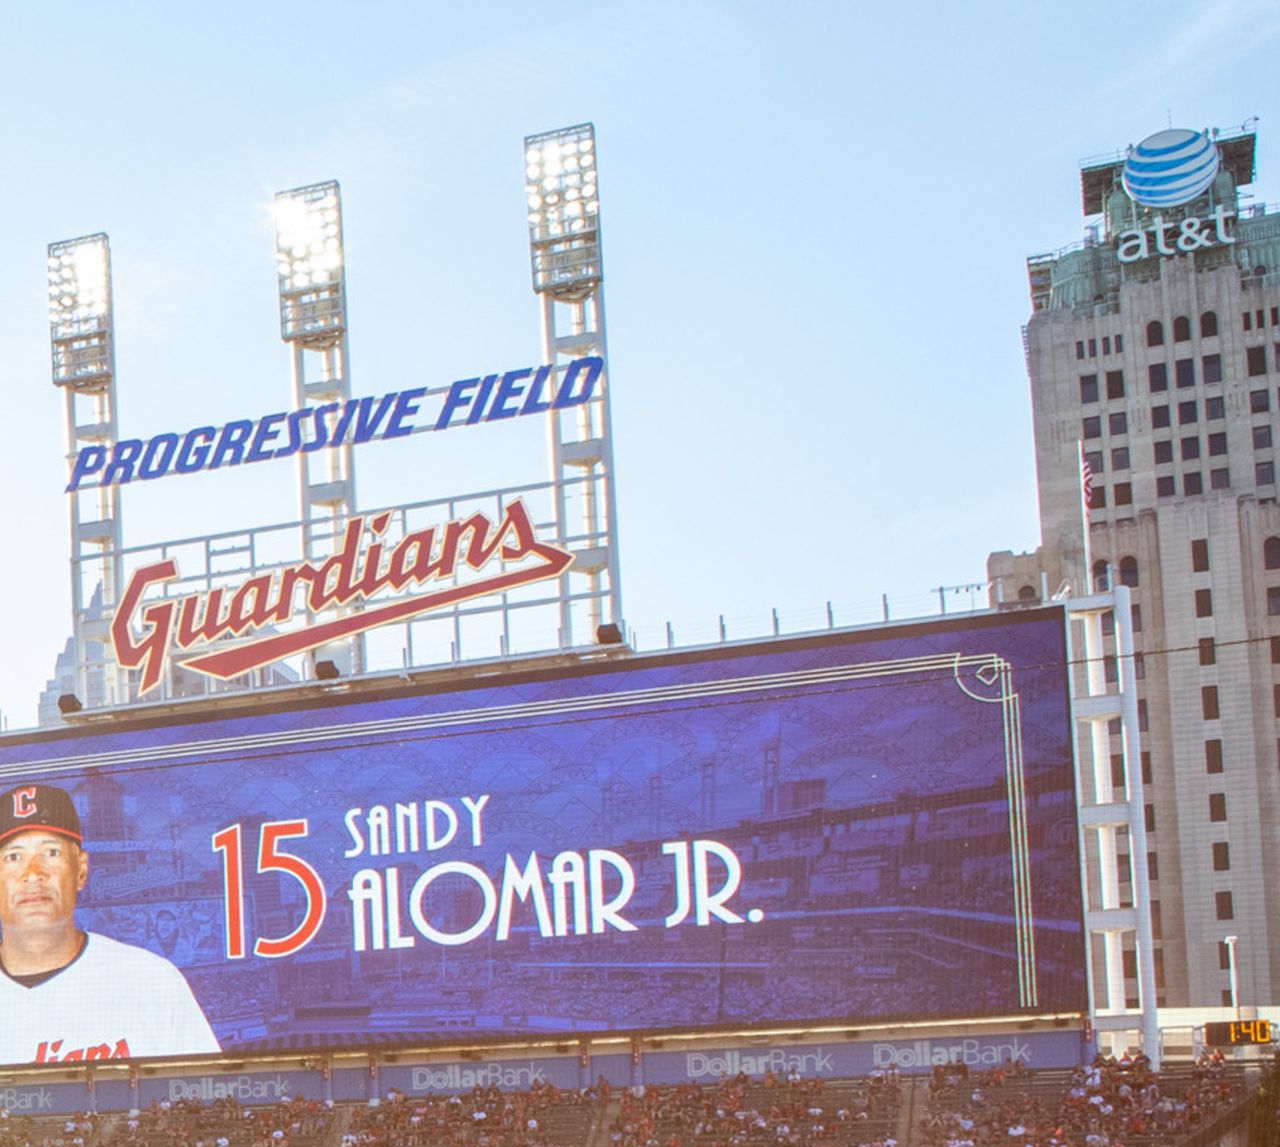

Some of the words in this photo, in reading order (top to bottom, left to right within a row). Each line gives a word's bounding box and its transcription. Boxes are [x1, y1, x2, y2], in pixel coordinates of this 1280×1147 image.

[1116, 203, 1236, 264] at&t
[66, 386, 428, 493] PROGRESSIVE
[435, 355, 604, 431] FIELD
[110, 496, 577, 697] Guardians
[344, 795, 490, 858] SANDY
[211, 818, 327, 960] 15
[347, 847, 639, 952] ALOMAR
[661, 839, 765, 928] JR.
[685, 1046, 834, 1077] DollarBank
[873, 1037, 1030, 1068] DollarBank
[1229, 1019, 1271, 1043] 1:40
[169, 1074, 290, 1101] DollarBank
[411, 1061, 546, 1090] DollarBank
